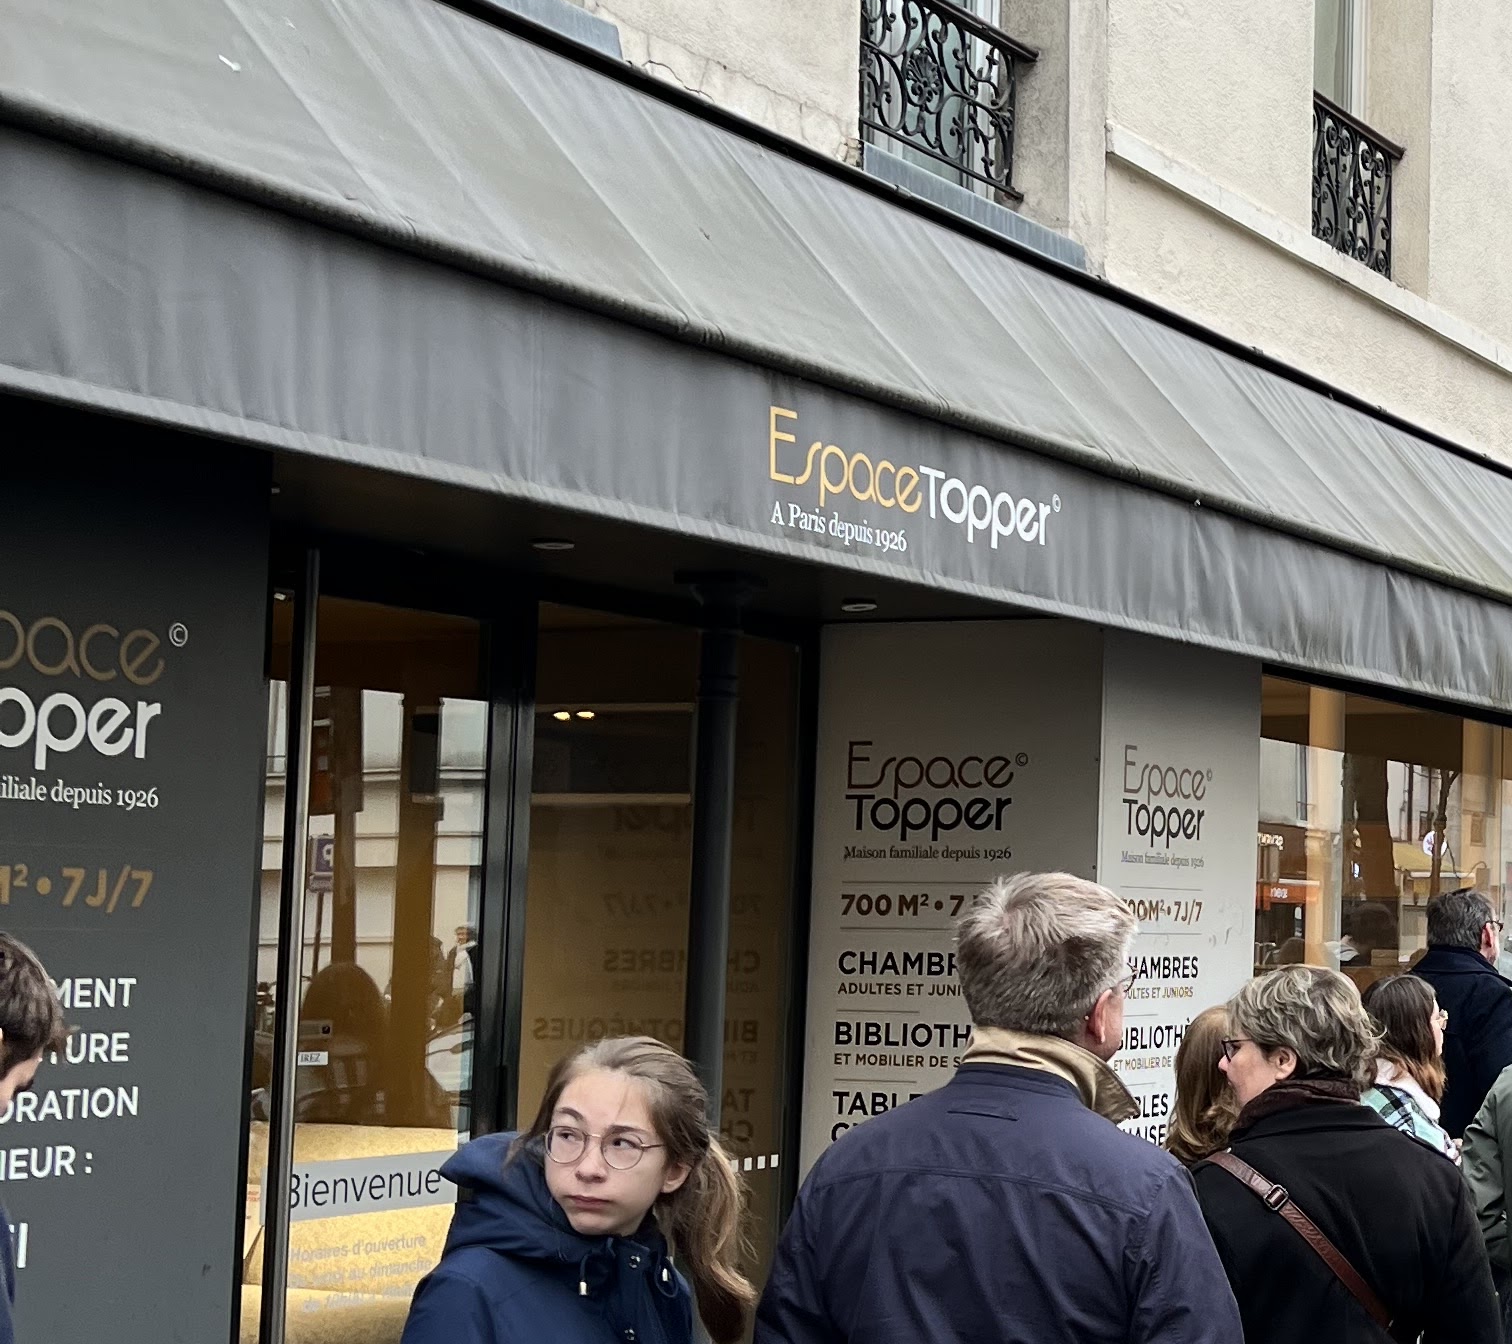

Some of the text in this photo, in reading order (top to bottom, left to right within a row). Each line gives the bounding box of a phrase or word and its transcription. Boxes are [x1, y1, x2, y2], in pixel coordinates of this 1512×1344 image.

[769, 406, 923, 513] Espace
[771, 501, 908, 552] A Paris depuis 1926
[51, 779, 112, 809] depuis
[116, 787, 159, 811] 1926
[845, 794, 1012, 842] Topper
[1122, 798, 1205, 849] Topper
[844, 845, 1012, 862] Maison familiale depuis 1926
[62, 865, 153, 913] 7J/7
[841, 893, 892, 916] 700
[837, 982, 962, 997] ADULTES ET JUNI
[834, 1021, 971, 1048] BIBLIOTH
[833, 1053, 851, 1065] ET
[855, 1054, 924, 1067] MOBILIER
[929, 1056, 948, 1067] DE
[1125, 1057, 1161, 1070] MOBILIER
[290, 1168, 441, 1209] Bienvenue
